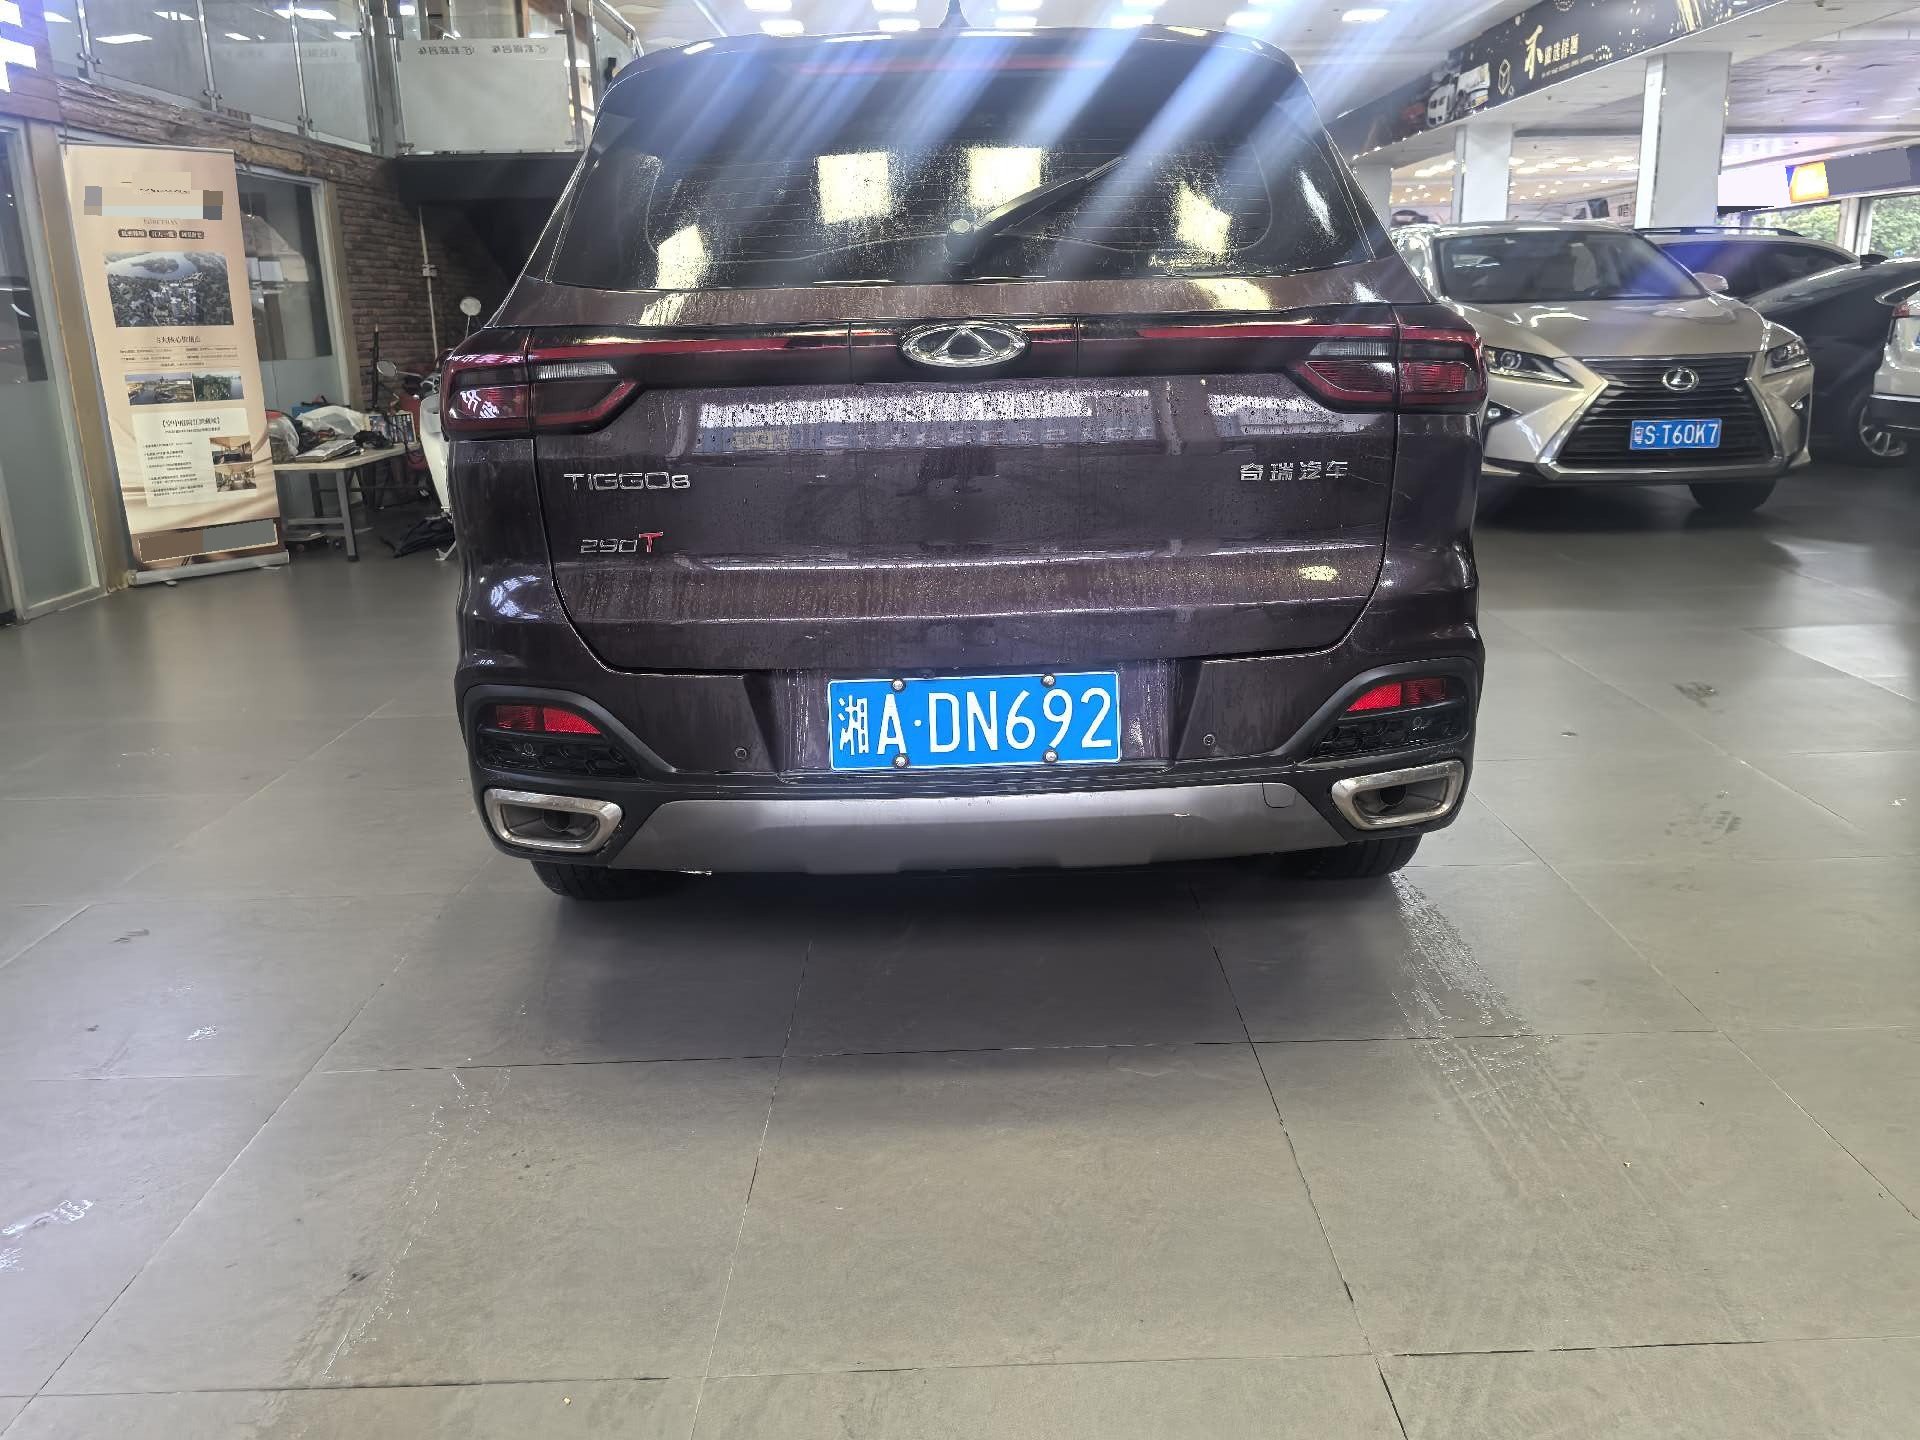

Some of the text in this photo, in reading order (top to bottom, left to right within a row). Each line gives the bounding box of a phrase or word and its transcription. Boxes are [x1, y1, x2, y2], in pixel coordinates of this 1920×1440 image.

[1240, 461, 1348, 481] 奇瑞汽车
[838, 687, 1112, 755] 湘A·DN692
